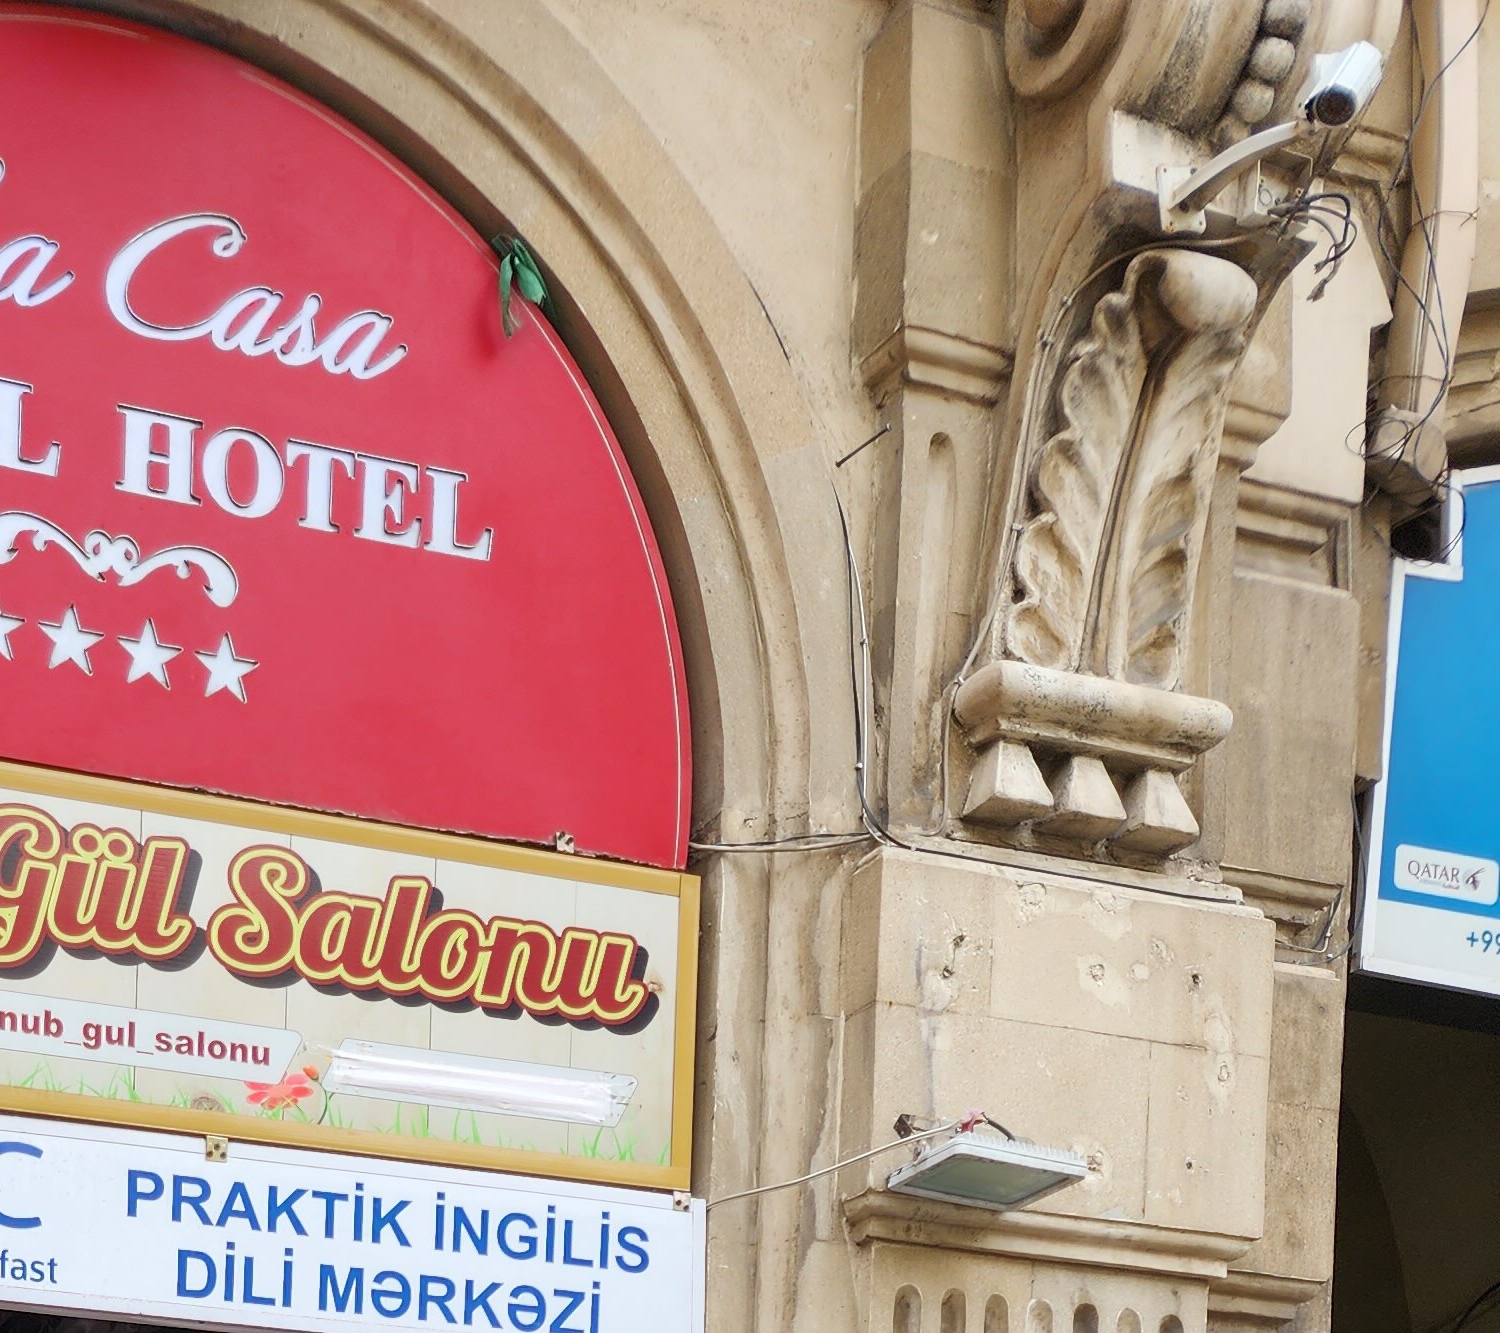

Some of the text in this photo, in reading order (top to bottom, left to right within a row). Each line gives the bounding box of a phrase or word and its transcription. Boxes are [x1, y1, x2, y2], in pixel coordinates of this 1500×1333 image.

[105, 211, 410, 381] Casa
[114, 402, 494, 562] HOTEL
[207, 841, 649, 1026] Salonu
[1407, 859, 1460, 883] QATAR
[126, 1168, 651, 1275] PRAKTİK İNGİLİS
[177, 1241, 294, 1309] DİLİ
